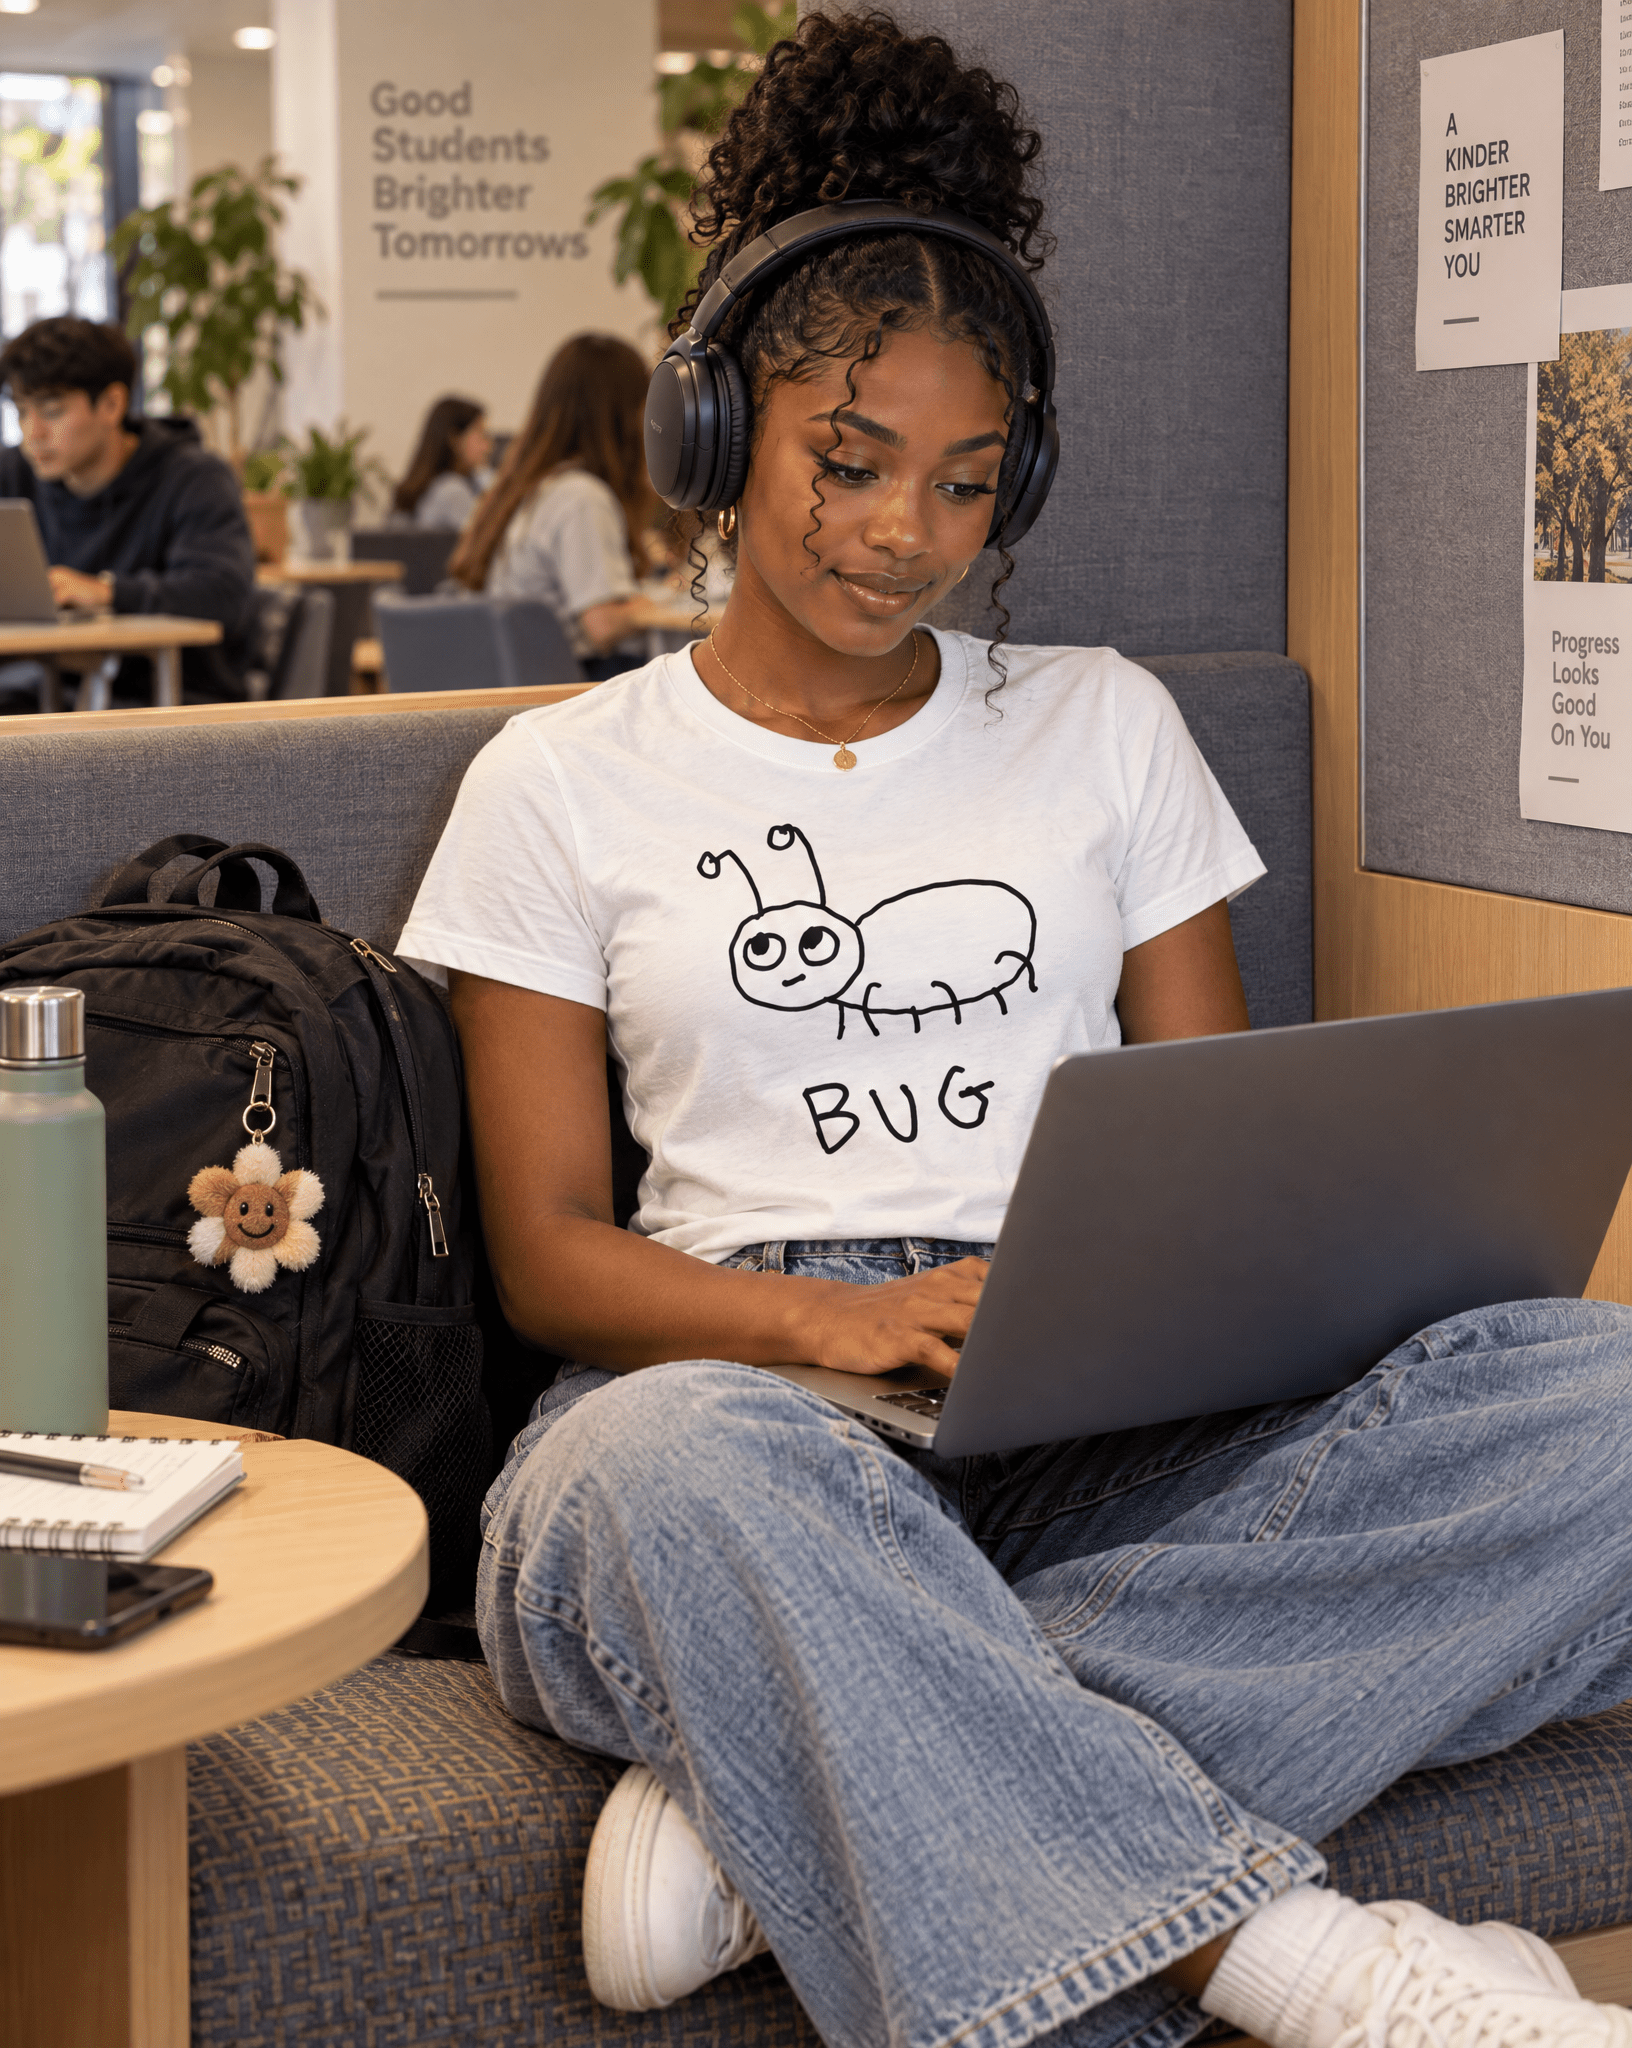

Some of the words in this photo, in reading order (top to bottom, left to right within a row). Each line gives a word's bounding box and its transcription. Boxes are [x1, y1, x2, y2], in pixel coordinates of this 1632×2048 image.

[370, 80, 473, 118] Good
[1445, 112, 1458, 137] A
[372, 125, 551, 163] Students
[1445, 139, 1510, 172] KINDER
[373, 173, 533, 220] Brighter
[1445, 172, 1531, 208] BRIGHTER
[372, 222, 590, 259] Tomorrows
[1444, 210, 1526, 243] SMARTER
[1443, 251, 1481, 279] YOU
[1552, 630, 1620, 660] Progress
[1552, 661, 1600, 686] Looks
[1551, 691, 1597, 717] Good
[1551, 722, 1575, 746] On
[1580, 724, 1611, 750] You
[802, 1065, 995, 1154] BUG
